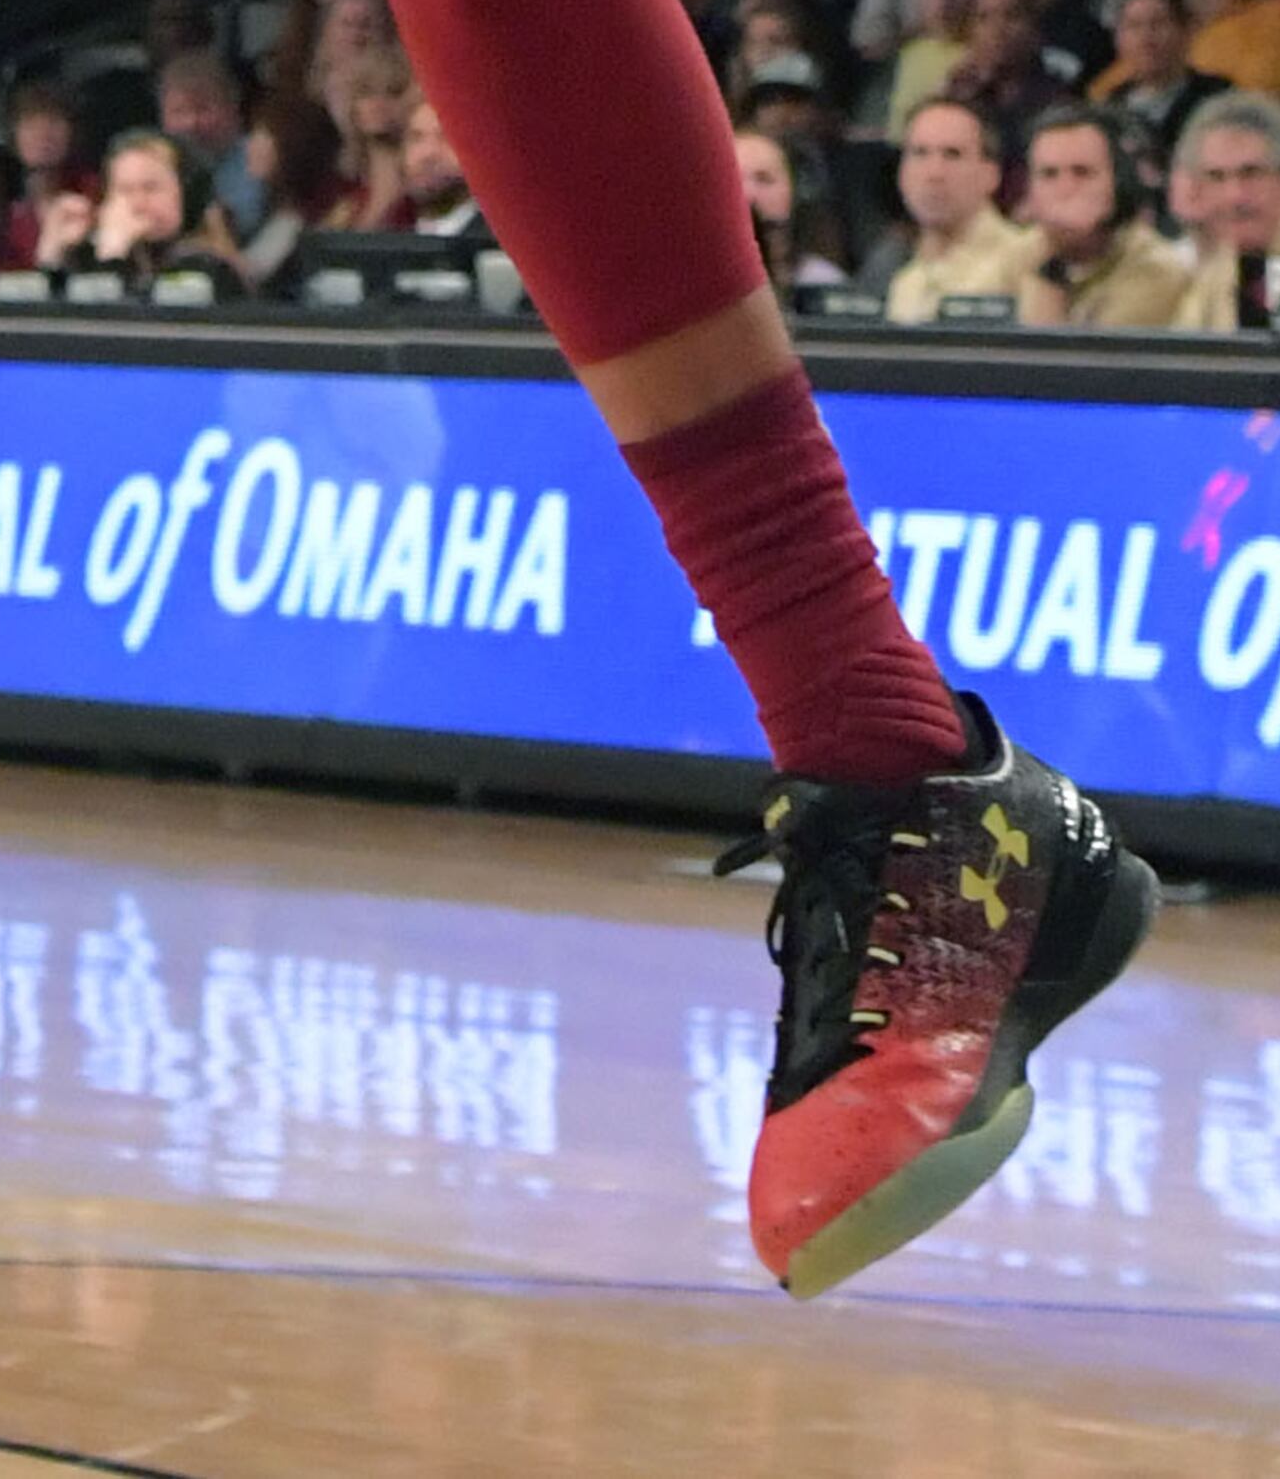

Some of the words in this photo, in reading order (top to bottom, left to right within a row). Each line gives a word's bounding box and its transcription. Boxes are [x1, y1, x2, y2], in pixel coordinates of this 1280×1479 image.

[84, 426, 235, 652] of
[211, 435, 570, 636] OMAHA
[692, 508, 1166, 683] TUAL
